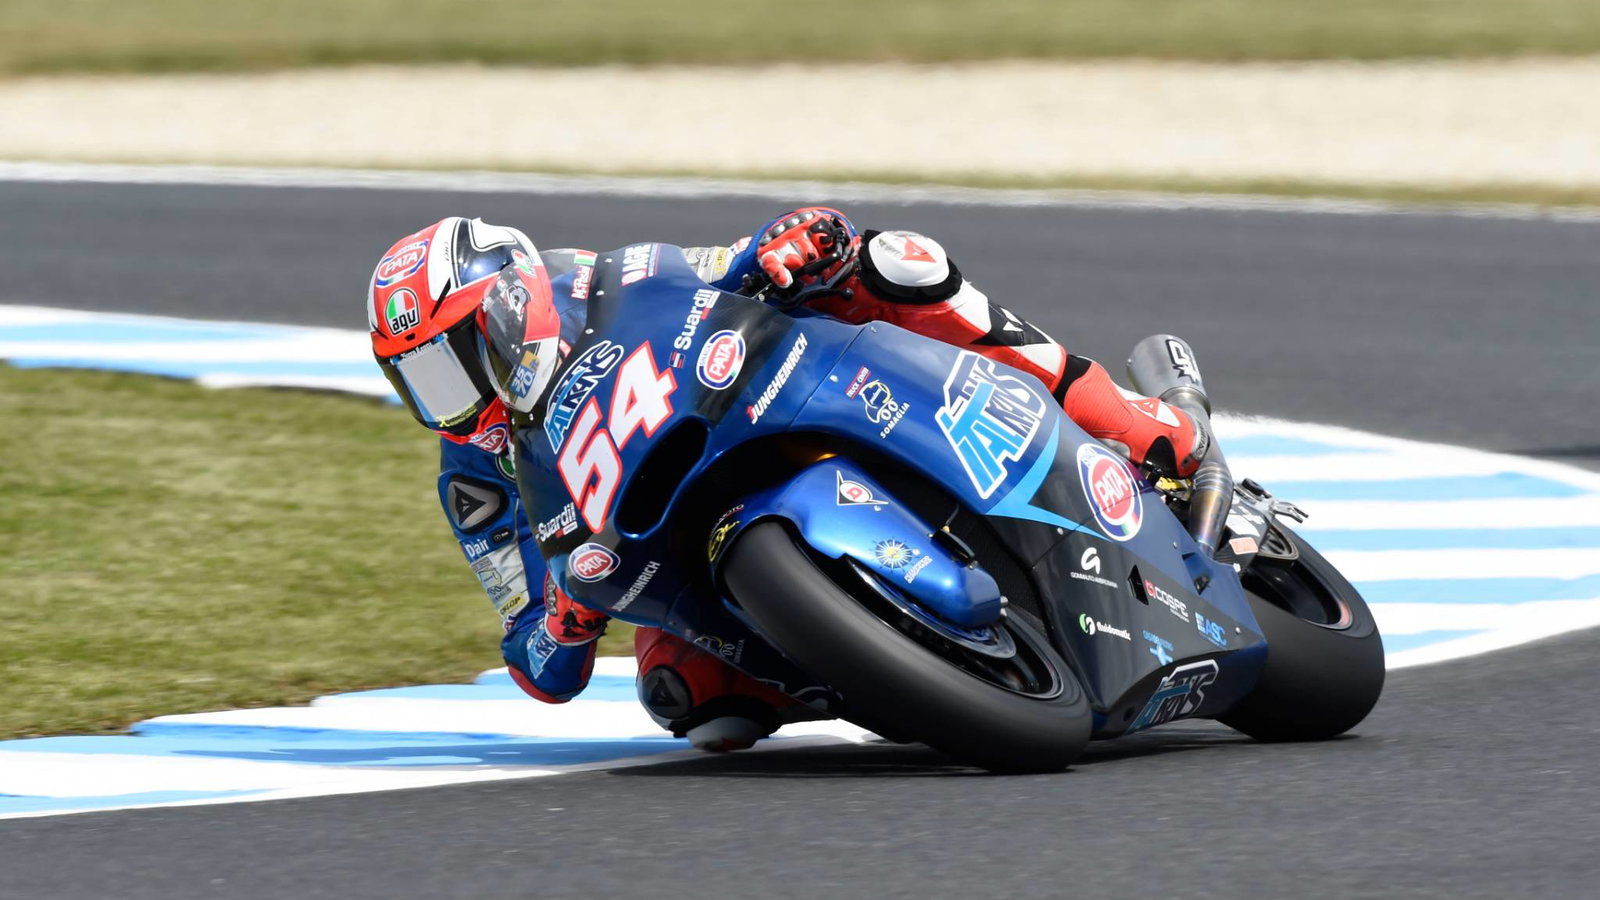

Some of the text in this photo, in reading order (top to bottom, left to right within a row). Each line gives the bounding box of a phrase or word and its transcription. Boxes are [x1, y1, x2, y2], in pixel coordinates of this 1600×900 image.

[384, 251, 418, 275] PATA
[391, 309, 416, 332] agv
[708, 340, 733, 377] PATA
[748, 332, 808, 424] JUNGHEINRICH
[557, 339, 678, 534] 54
[880, 402, 910, 438] SOMAGLIA
[1094, 465, 1130, 513] PATA
[577, 555, 608, 576] PATA
